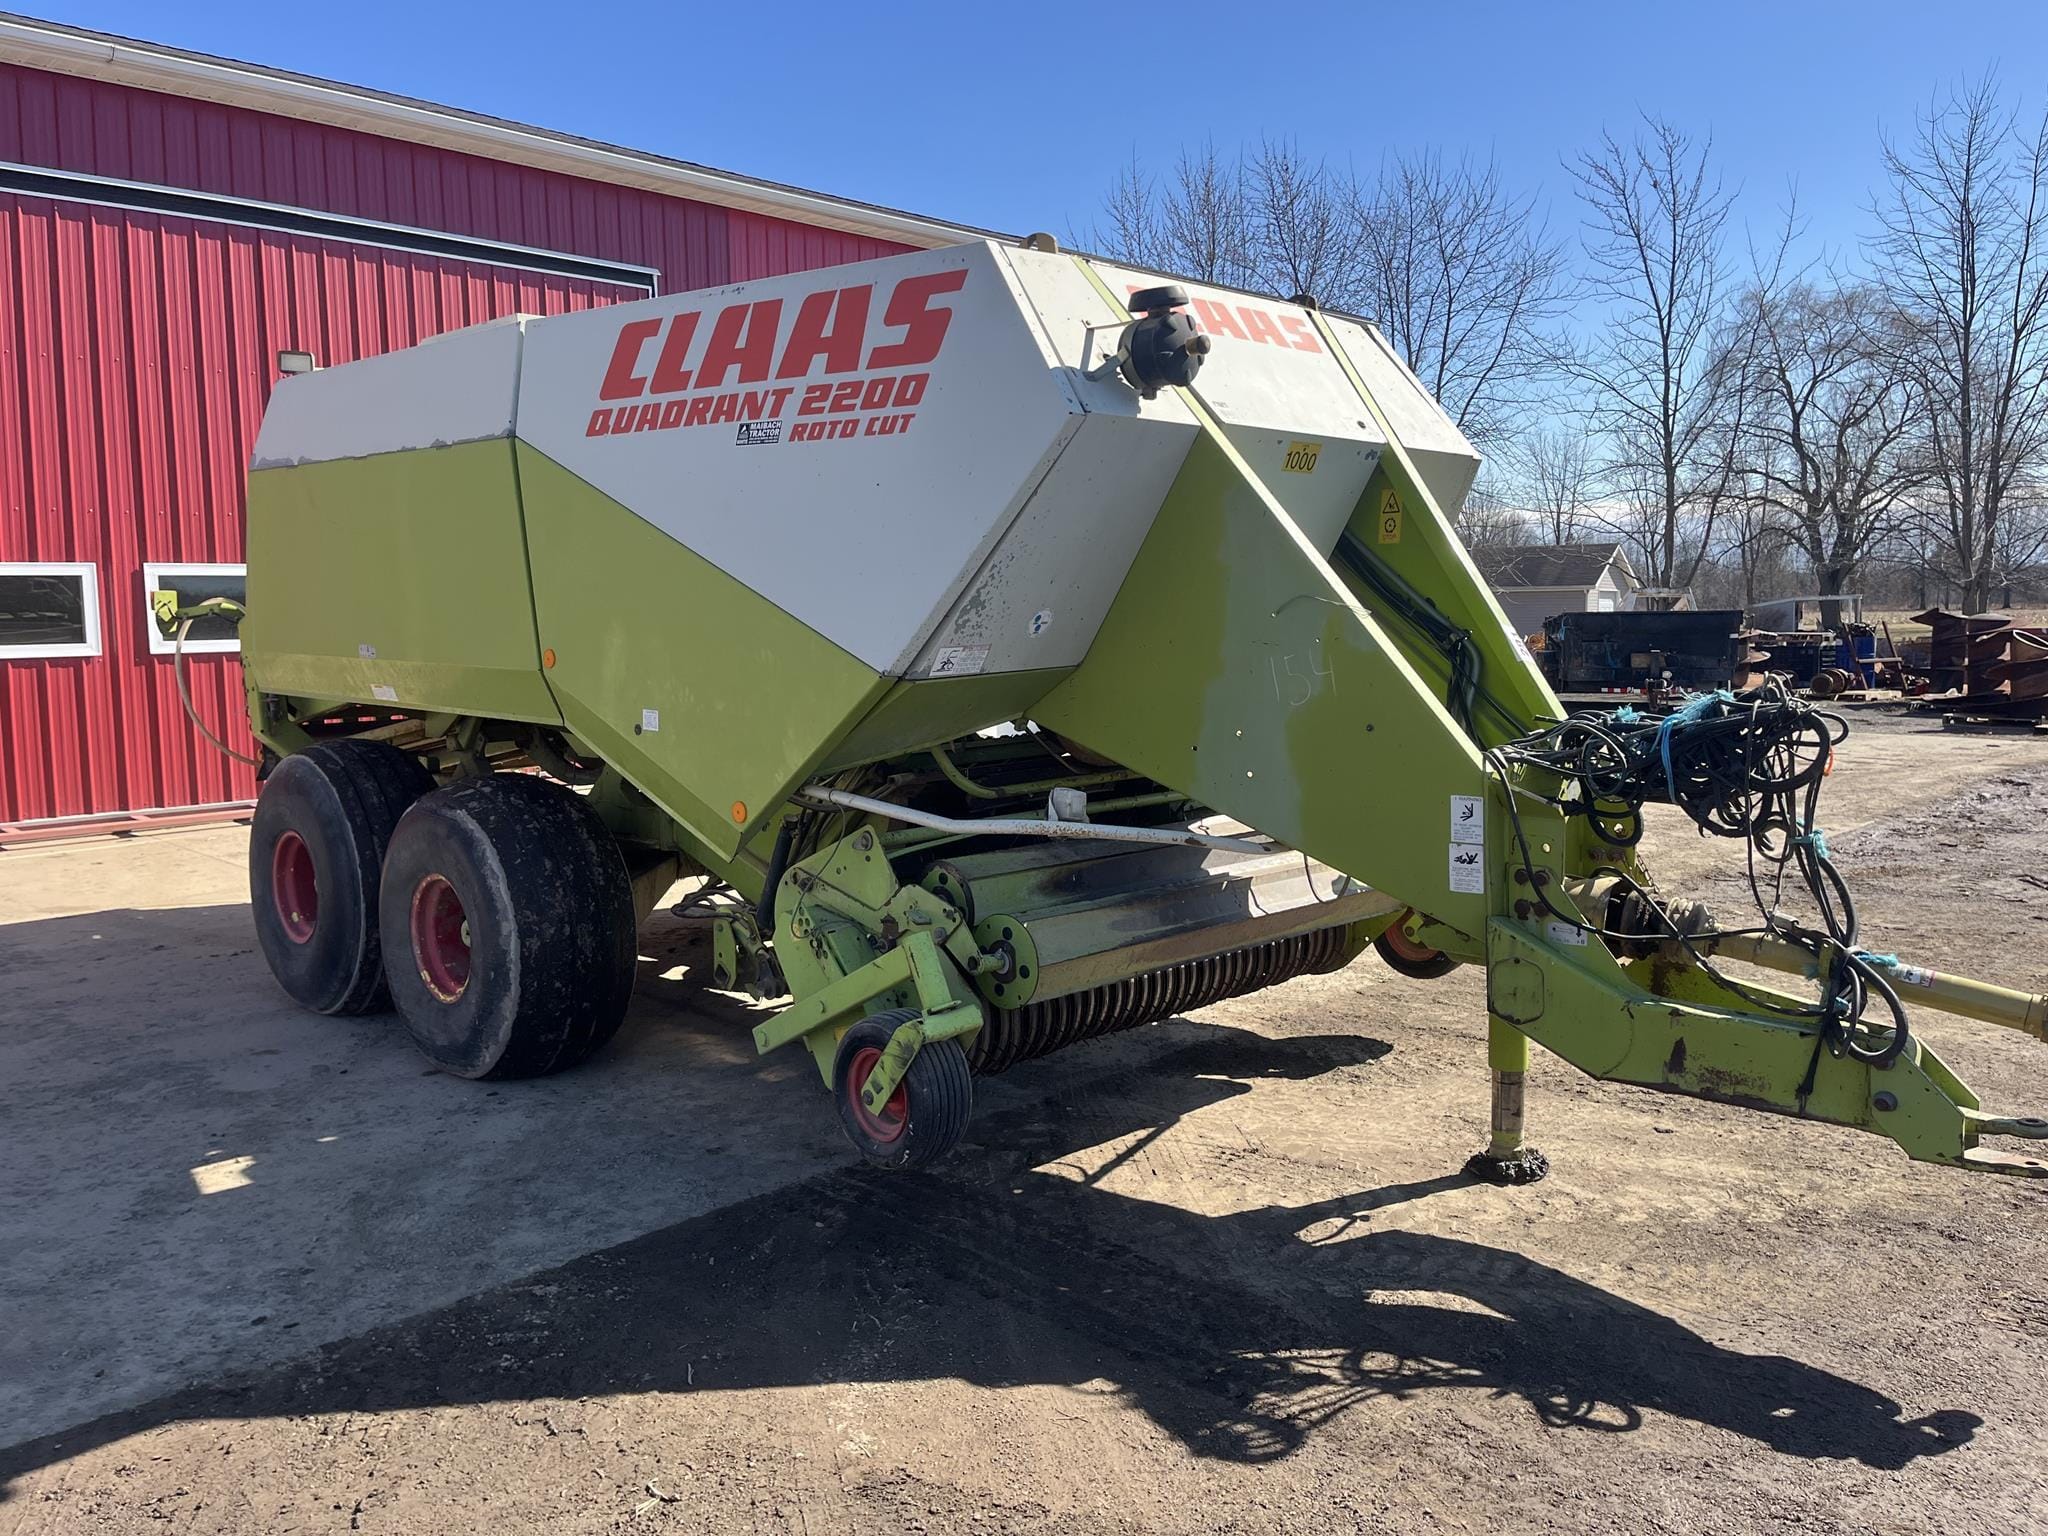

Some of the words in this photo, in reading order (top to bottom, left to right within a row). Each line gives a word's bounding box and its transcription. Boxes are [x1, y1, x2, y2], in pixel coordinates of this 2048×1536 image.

[599, 269, 969, 401] CLAAS
[1127, 286, 1323, 354] AAS
[586, 387, 798, 437] QUADRANT
[797, 373, 931, 417] 2200
[750, 421, 782, 430] MAIBACH
[749, 428, 780, 438] TRACTOR
[788, 418, 861, 442] ROTO
[864, 414, 916, 436] CUT
[1284, 451, 1317, 471] 1000
[1270, 648, 1337, 706] 154
